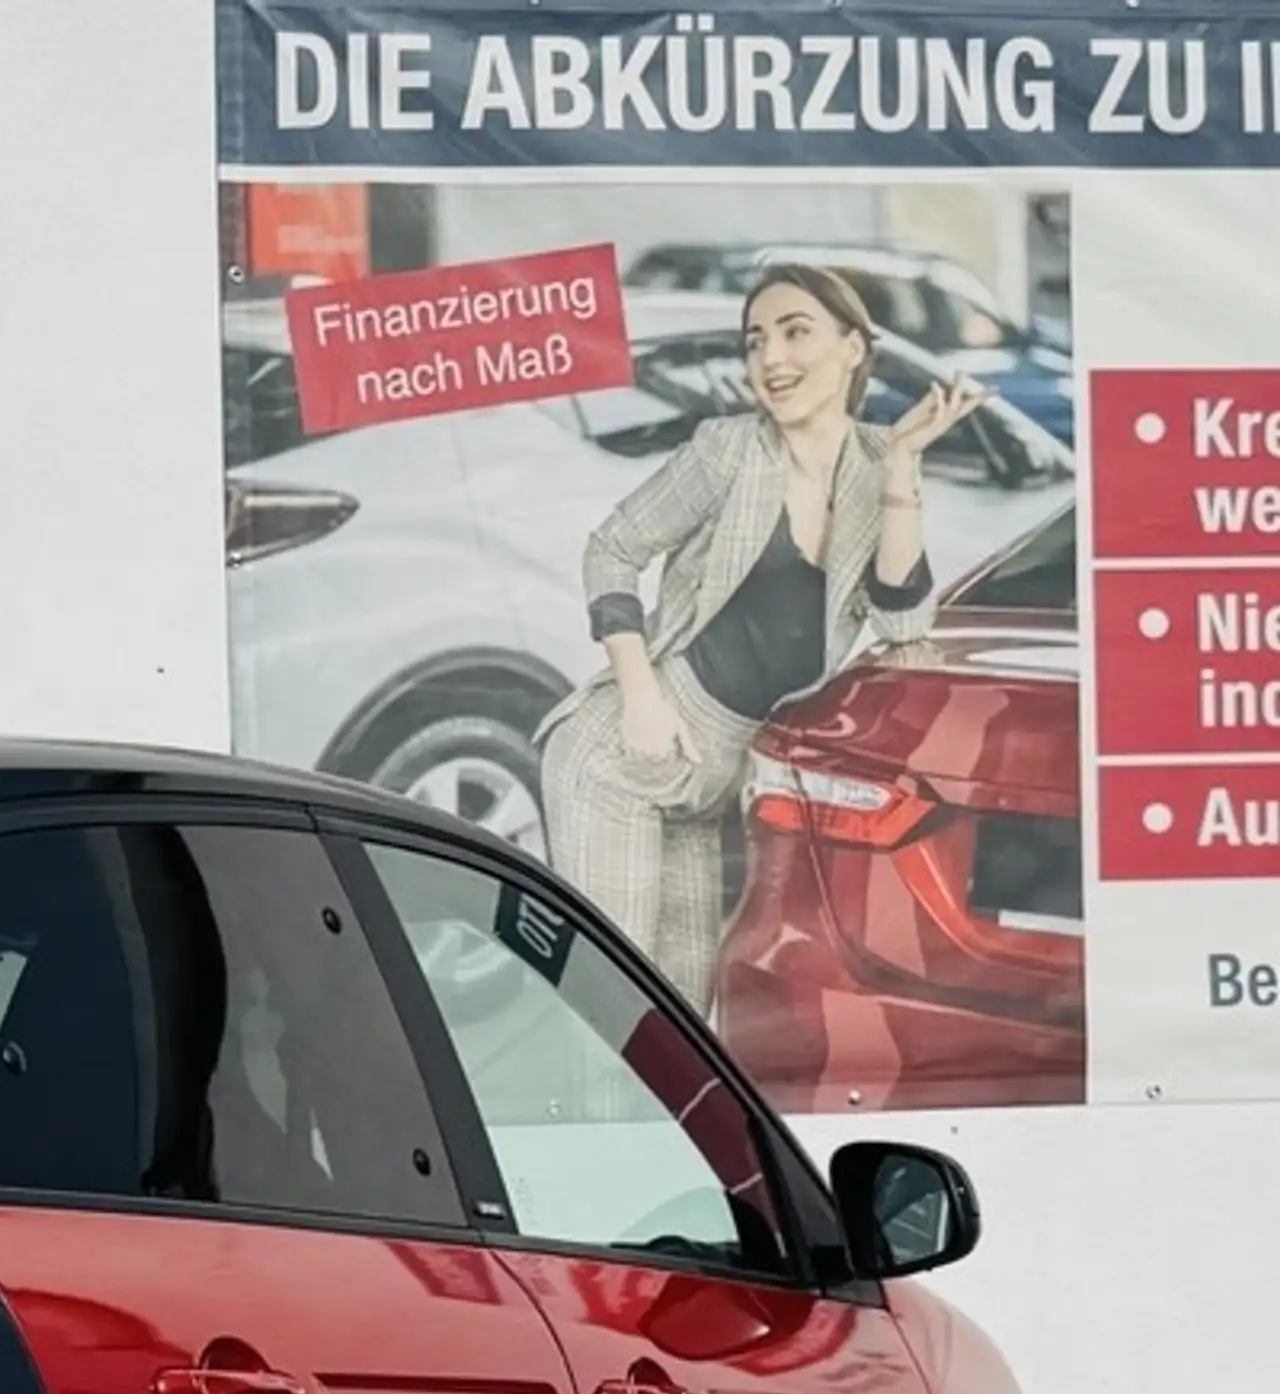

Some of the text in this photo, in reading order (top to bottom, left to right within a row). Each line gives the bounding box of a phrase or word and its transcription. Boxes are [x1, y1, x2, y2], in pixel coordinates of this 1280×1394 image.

[275, 31, 434, 130] DIE
[461, 14, 1055, 133] ABKÜRZUNG
[1088, 37, 1208, 134] ZU
[313, 276, 598, 348] Finanzierung
[356, 334, 572, 404] nach Maß
[1197, 786, 1280, 848] Au
[1207, 952, 1279, 1008] Be
